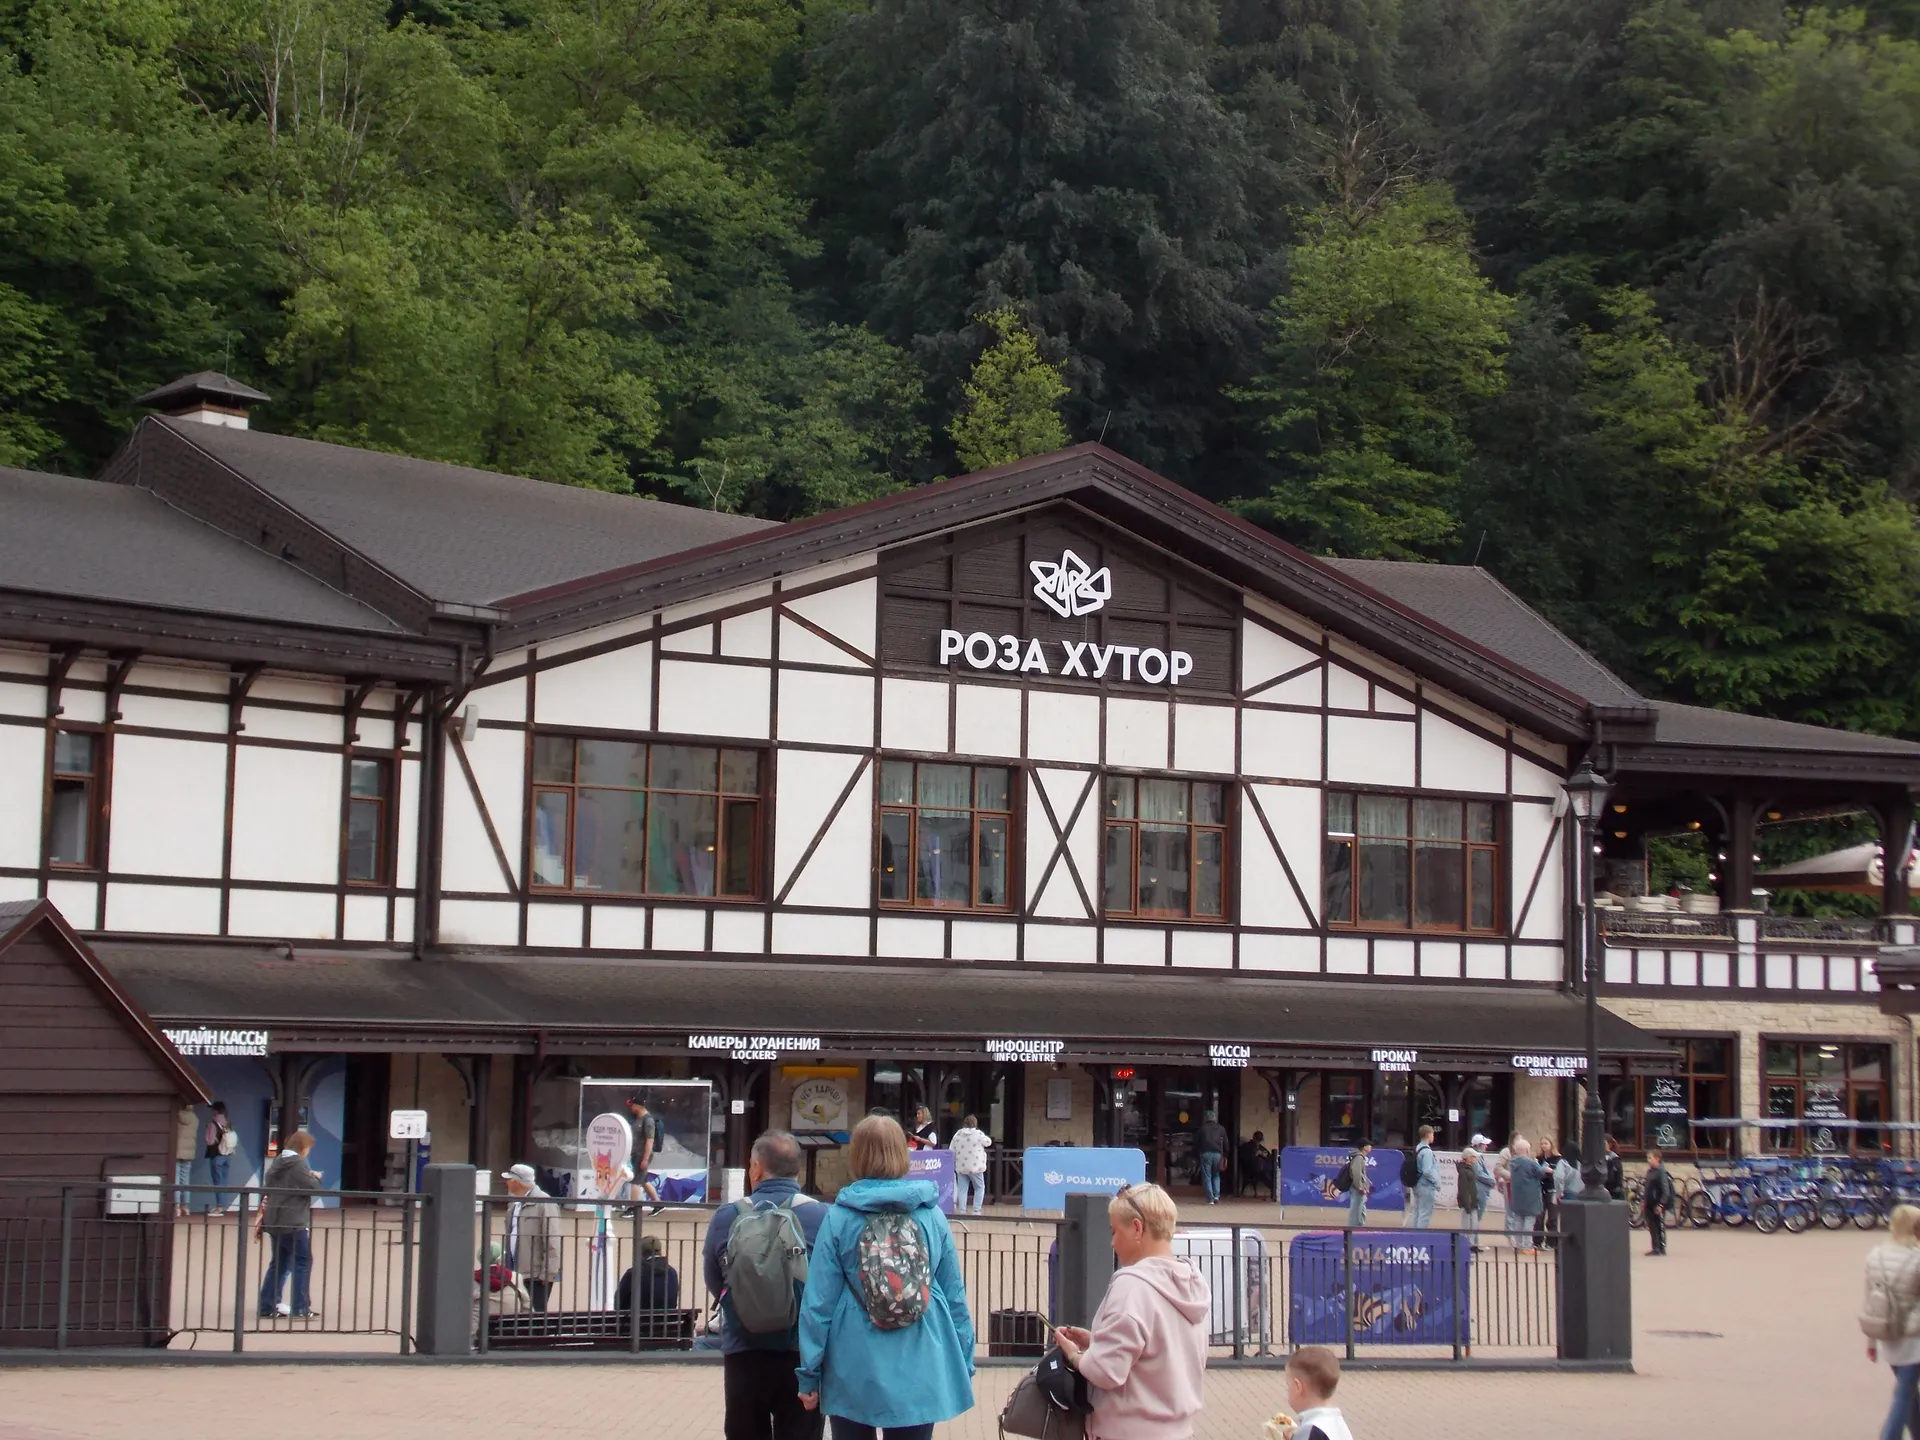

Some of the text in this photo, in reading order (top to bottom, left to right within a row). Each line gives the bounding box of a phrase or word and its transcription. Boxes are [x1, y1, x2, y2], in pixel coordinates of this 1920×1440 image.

[939, 629, 1194, 685] РОЗА ХУТОР
[220, 1030, 268, 1045] КАССЫ
[688, 1035, 820, 1050] КАМЕРЫ ХРАНЕНИЯ
[204, 1045, 266, 1055] TERMINALS
[986, 1039, 1064, 1053] ИНФОЦЕНТР
[1209, 1044, 1251, 1058] КАССЫ
[732, 1050, 777, 1060] LOCKERS
[994, 1052, 1056, 1062] INFO CENTRE
[1372, 1050, 1418, 1063] ПРОКАТ
[1212, 1057, 1248, 1067] TICKETS
[1380, 1062, 1411, 1071] RENTAL
[1513, 1056, 1555, 1068] СЕРВИС
[1528, 1068, 1576, 1077] SKI SERVICE
[1314, 1154, 1346, 1165] 2014
[1066, 1175, 1127, 1187] РОЗА ХУТОР
